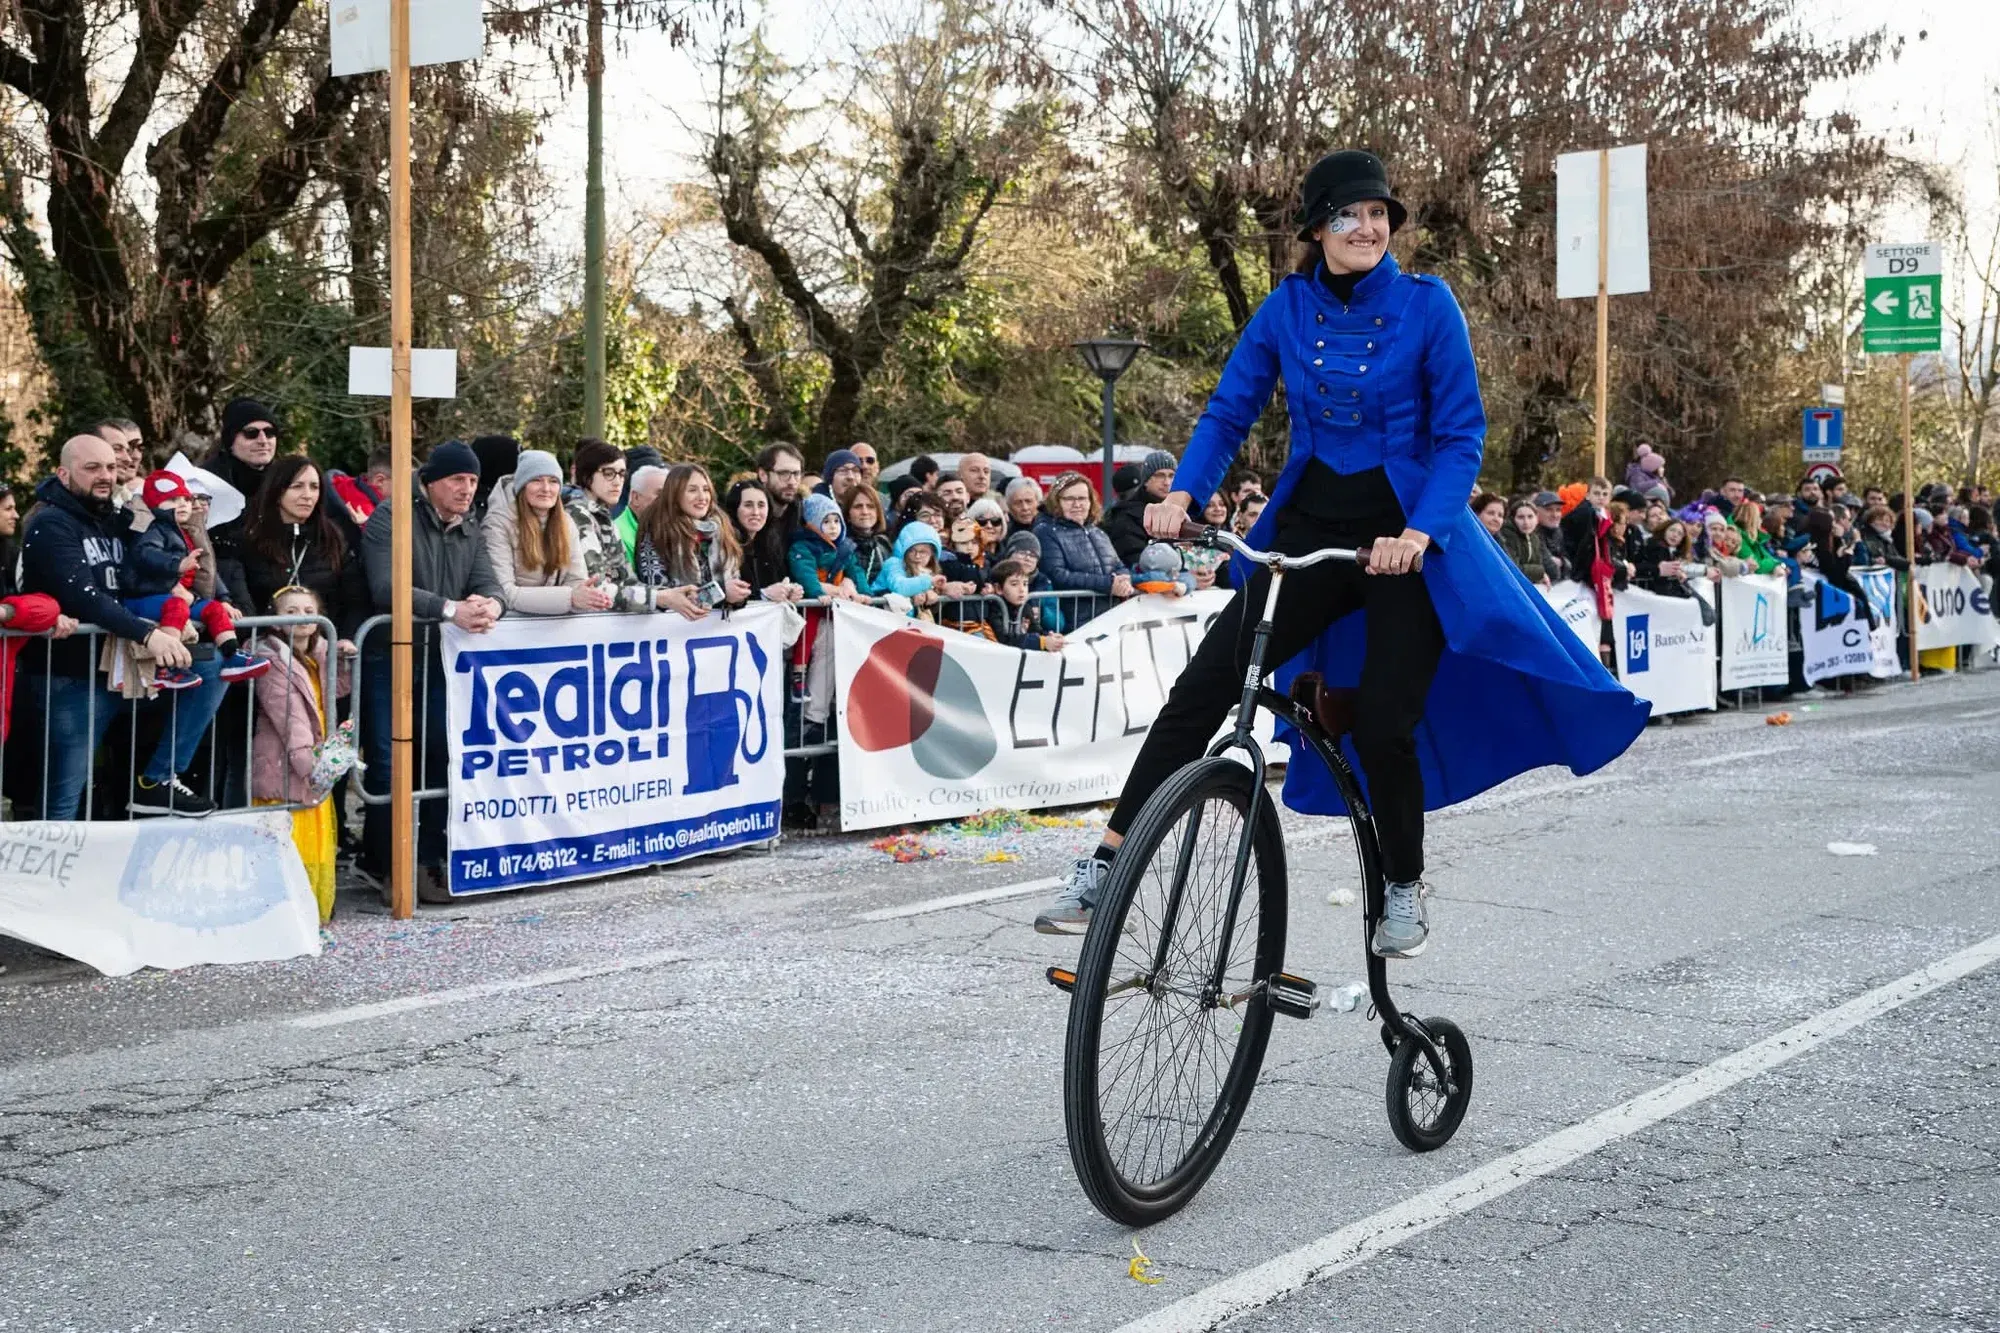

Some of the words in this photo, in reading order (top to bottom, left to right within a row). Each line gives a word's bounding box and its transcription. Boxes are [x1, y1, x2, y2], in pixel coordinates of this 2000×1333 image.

[1876, 245, 1931, 259] SETTORE
[1888, 257, 1919, 274] D9
[1654, 632, 1687, 648] Banco
[455, 639, 671, 746] Tealdi
[461, 732, 670, 779] PETROLI
[463, 795, 557, 823] PRODOTTI
[567, 778, 672, 812] PETROLIFERI
[928, 779, 1062, 807] Costruction
[1065, 771, 1120, 794] studio
[461, 858, 493, 880] Tel.
[499, 847, 578, 877] 0174/66122
[592, 835, 641, 863] E-mail:
[644, 811, 775, 853] info@tealdipetroli.it
